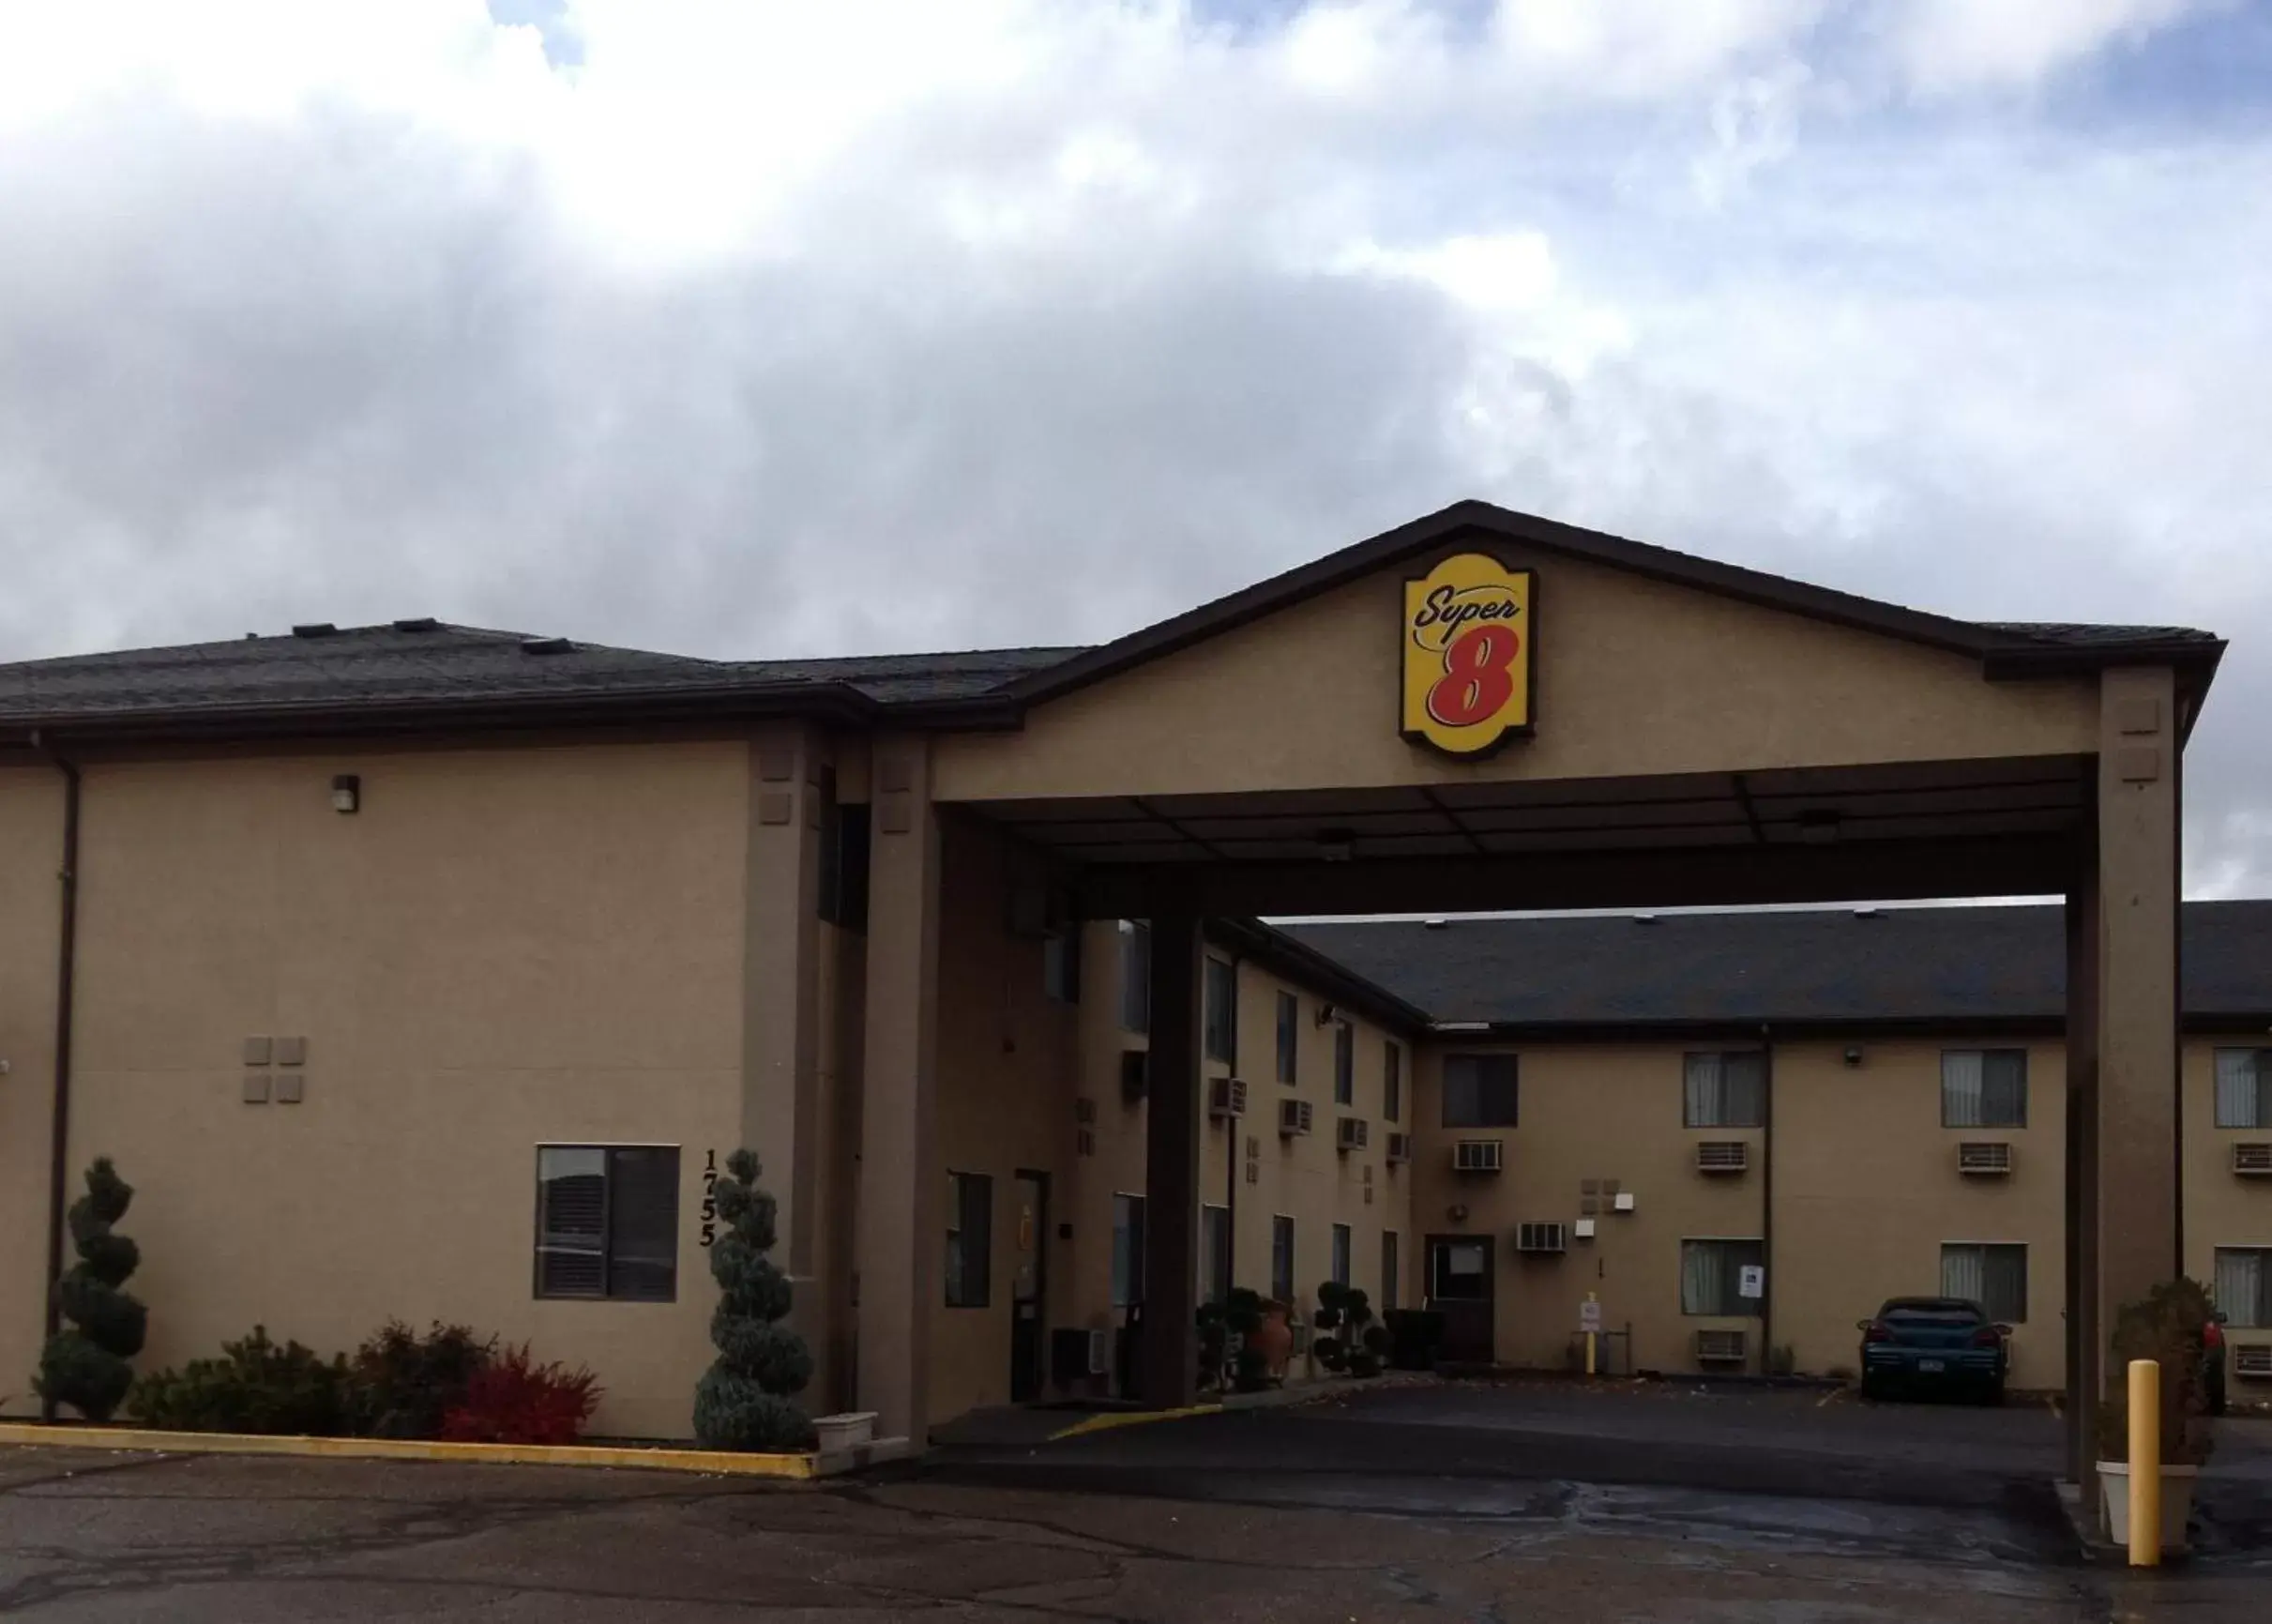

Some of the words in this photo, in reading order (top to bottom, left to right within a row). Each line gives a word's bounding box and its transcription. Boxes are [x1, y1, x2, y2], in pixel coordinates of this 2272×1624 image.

[1413, 584, 1520, 646] Super
[1425, 624, 1520, 727] 8
[699, 1148, 718, 1247] 1755
